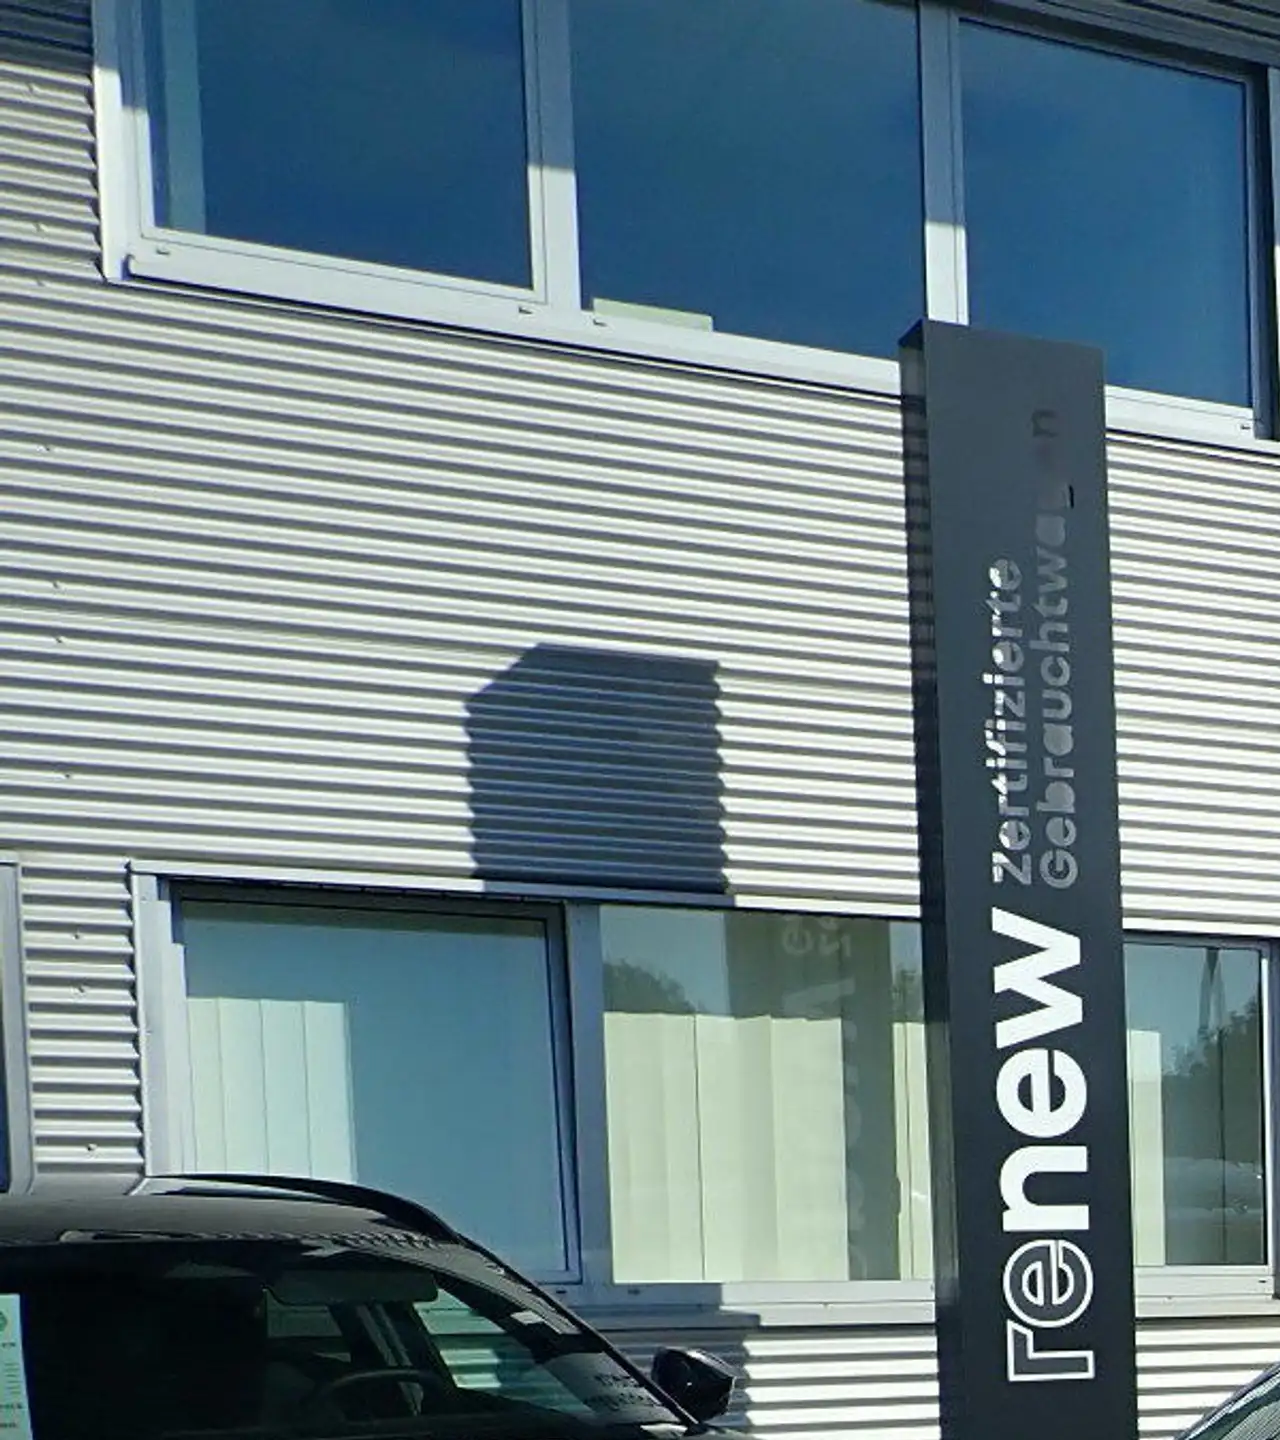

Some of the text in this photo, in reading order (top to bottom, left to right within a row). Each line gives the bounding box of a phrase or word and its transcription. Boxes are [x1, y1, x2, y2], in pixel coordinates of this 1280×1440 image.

[982, 558, 1032, 885] Zertifizierte
[1029, 408, 1079, 889] Gebrauchtwan
[992, 907, 1095, 1382] renew
